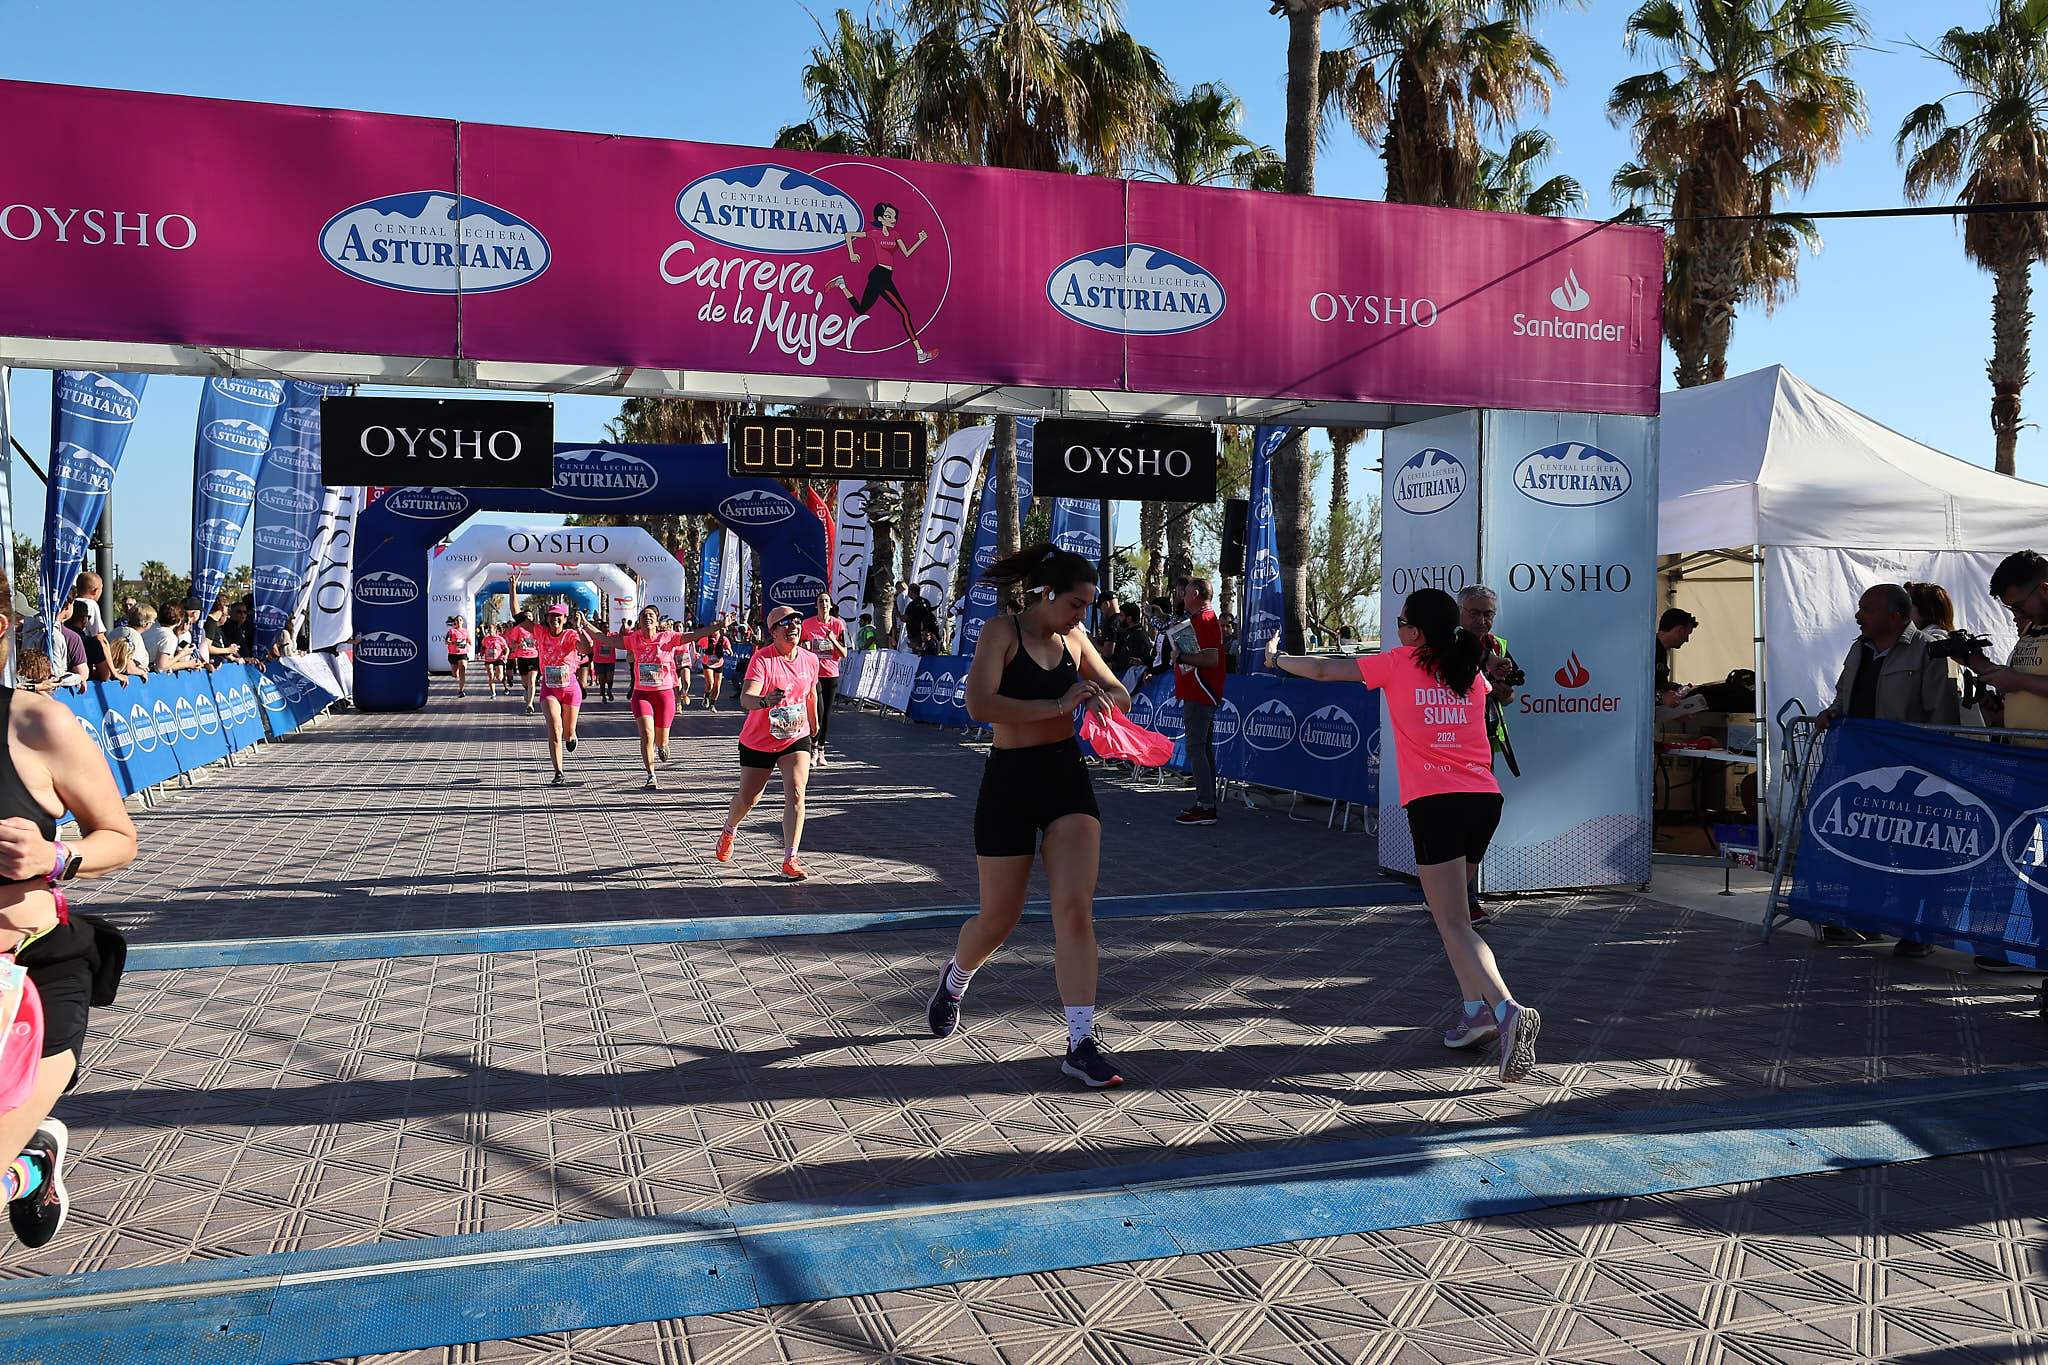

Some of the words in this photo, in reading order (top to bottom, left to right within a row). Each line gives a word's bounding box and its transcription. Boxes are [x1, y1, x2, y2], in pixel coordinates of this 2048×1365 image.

[691, 191, 848, 235] ASTURIANA
[721, 191, 779, 204] CENTRAL
[785, 197, 843, 209] LECHERA
[0, 203, 198, 251] OYSHO
[374, 223, 447, 237] CENTRAL
[338, 223, 533, 271] ASTURIANA
[659, 240, 814, 294] Carrera
[1089, 272, 1145, 284] CENTRAL
[1151, 277, 1207, 288] LECHERA
[1061, 273, 1213, 314] ASTURIANA
[1310, 291, 1439, 328] OYSHO
[697, 291, 727, 322] de
[733, 291, 754, 325] la
[749, 292, 870, 366] Mujer
[1512, 313, 1625, 342] Santander
[57, 387, 132, 420] STURIANA
[217, 377, 280, 404] ASTURIAN
[283, 411, 320, 429] ASTURIA
[208, 426, 267, 451] ASTURIAN
[360, 424, 522, 461] OYSHO
[1064, 445, 1192, 477] OYSHO
[1397, 476, 1460, 501] ASTURIANA
[1522, 464, 1623, 491] ASTURIANA
[390, 495, 462, 511] ASTURIANA
[725, 503, 791, 517] ASTURIANA
[508, 533, 609, 554] OYSHO
[918, 455, 972, 610] OYSHO
[317, 496, 352, 613] OYSH
[446, 554, 478, 562] OYSHO
[637, 554, 667, 562] OYSHO
[358, 583, 414, 598] ASTURIANA
[1392, 564, 1465, 595] OYSHO
[1509, 563, 1632, 593] OYSHO
[432, 594, 462, 602] OYSHO
[652, 595, 681, 603] OYSHO
[357, 643, 413, 657] ASTURIANA
[1424, 707, 1468, 725] SUMA
[1520, 692, 1621, 714] Santander
[1246, 717, 1291, 740] ASTURIANA
[1303, 722, 1352, 749] ASTURIANA
[1437, 732, 1456, 742] 2024
[1853, 796, 1911, 812] CENTRAL
[1917, 805, 1981, 823] LECHERA
[1818, 796, 1980, 857] ASTURIANA
